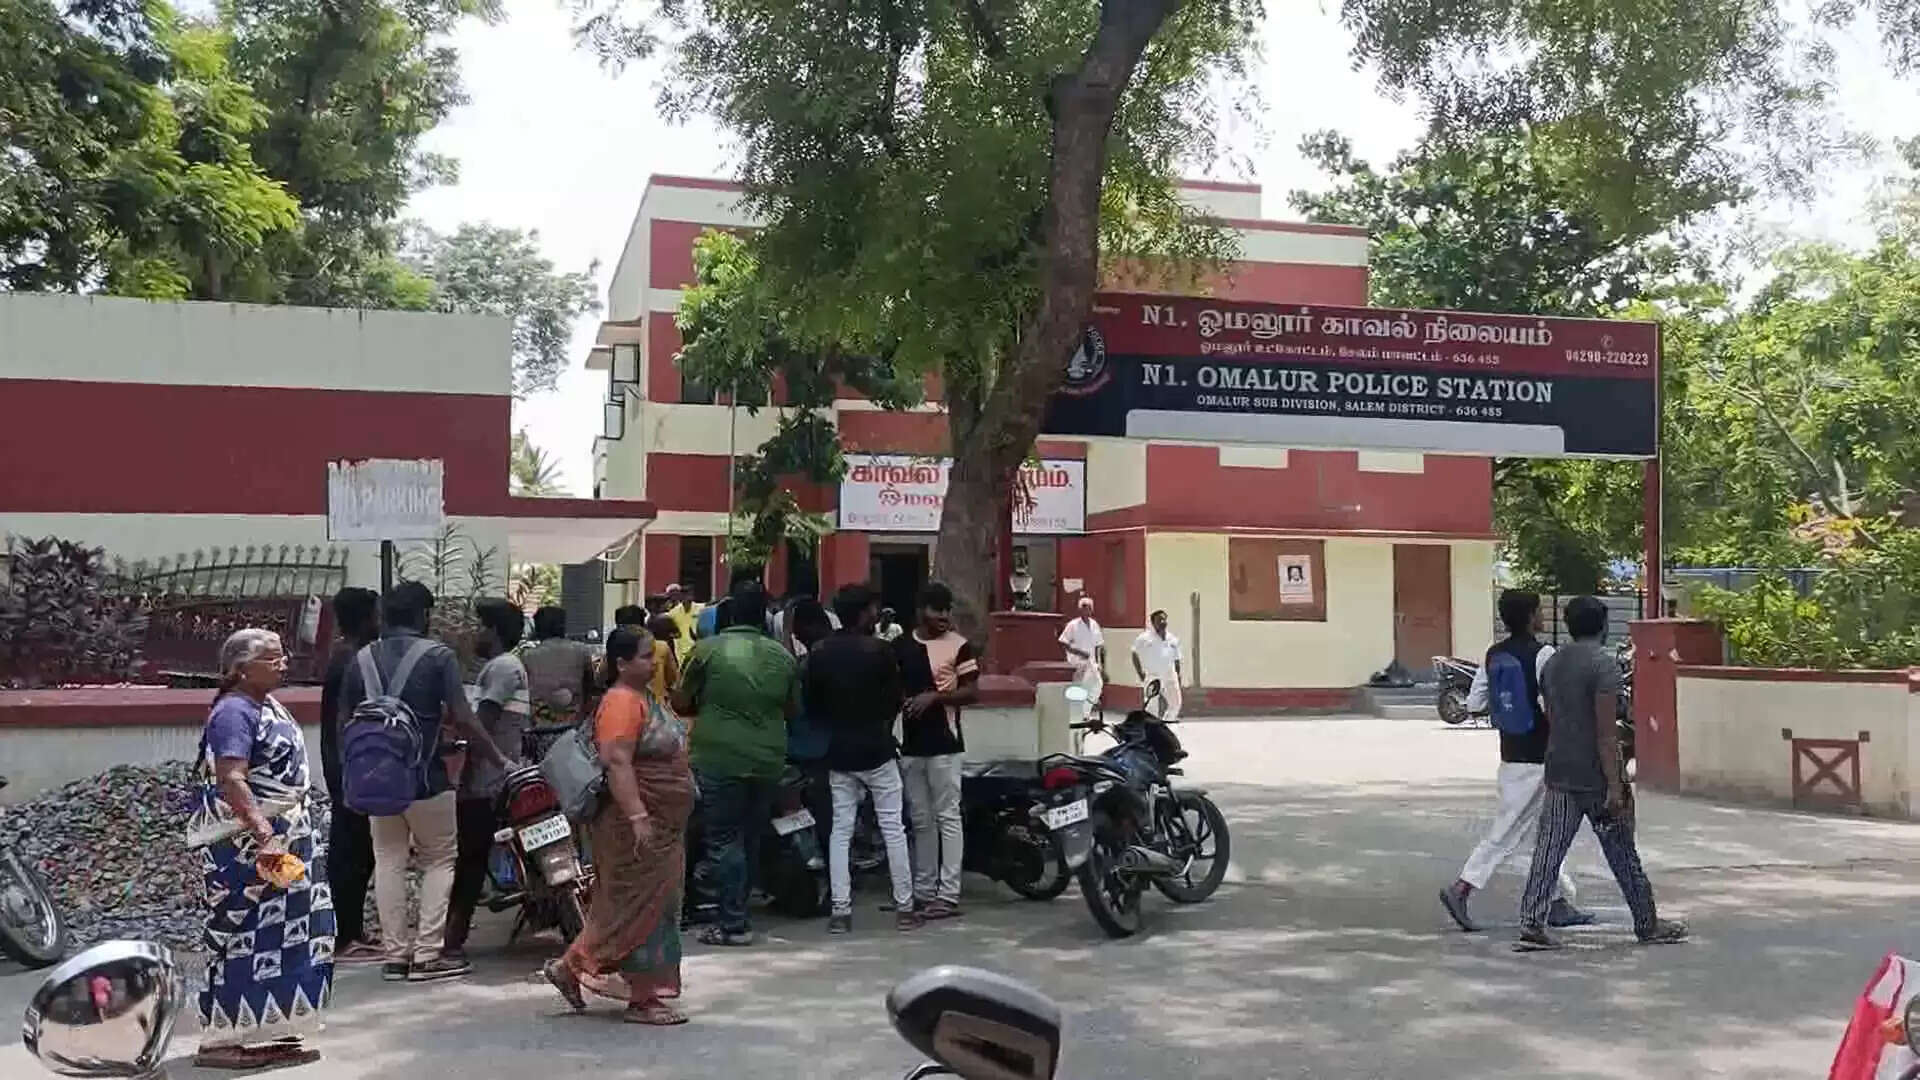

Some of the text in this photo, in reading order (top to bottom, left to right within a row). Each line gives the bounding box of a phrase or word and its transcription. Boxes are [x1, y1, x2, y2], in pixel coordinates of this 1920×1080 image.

[1142, 304, 1553, 346] N1. ஓமலூர் காவல் நிலையம்
[1453, 353, 1475, 364] 636
[1565, 349, 1649, 366] 04290-220223
[1142, 364, 1187, 386] N1.
[1197, 366, 1319, 393] OMALUR
[1328, 372, 1429, 398] POLICE
[1437, 377, 1553, 403] STATION
[1197, 395, 1250, 407] OMALUR
[1254, 399, 1278, 409] SUB
[1282, 400, 1341, 412] DIVISION,
[1345, 401, 1385, 413] SALEM
[1389, 404, 1446, 416] DISTRICT
[1456, 406, 1478, 416] 636
[1481, 407, 1503, 417] 455
